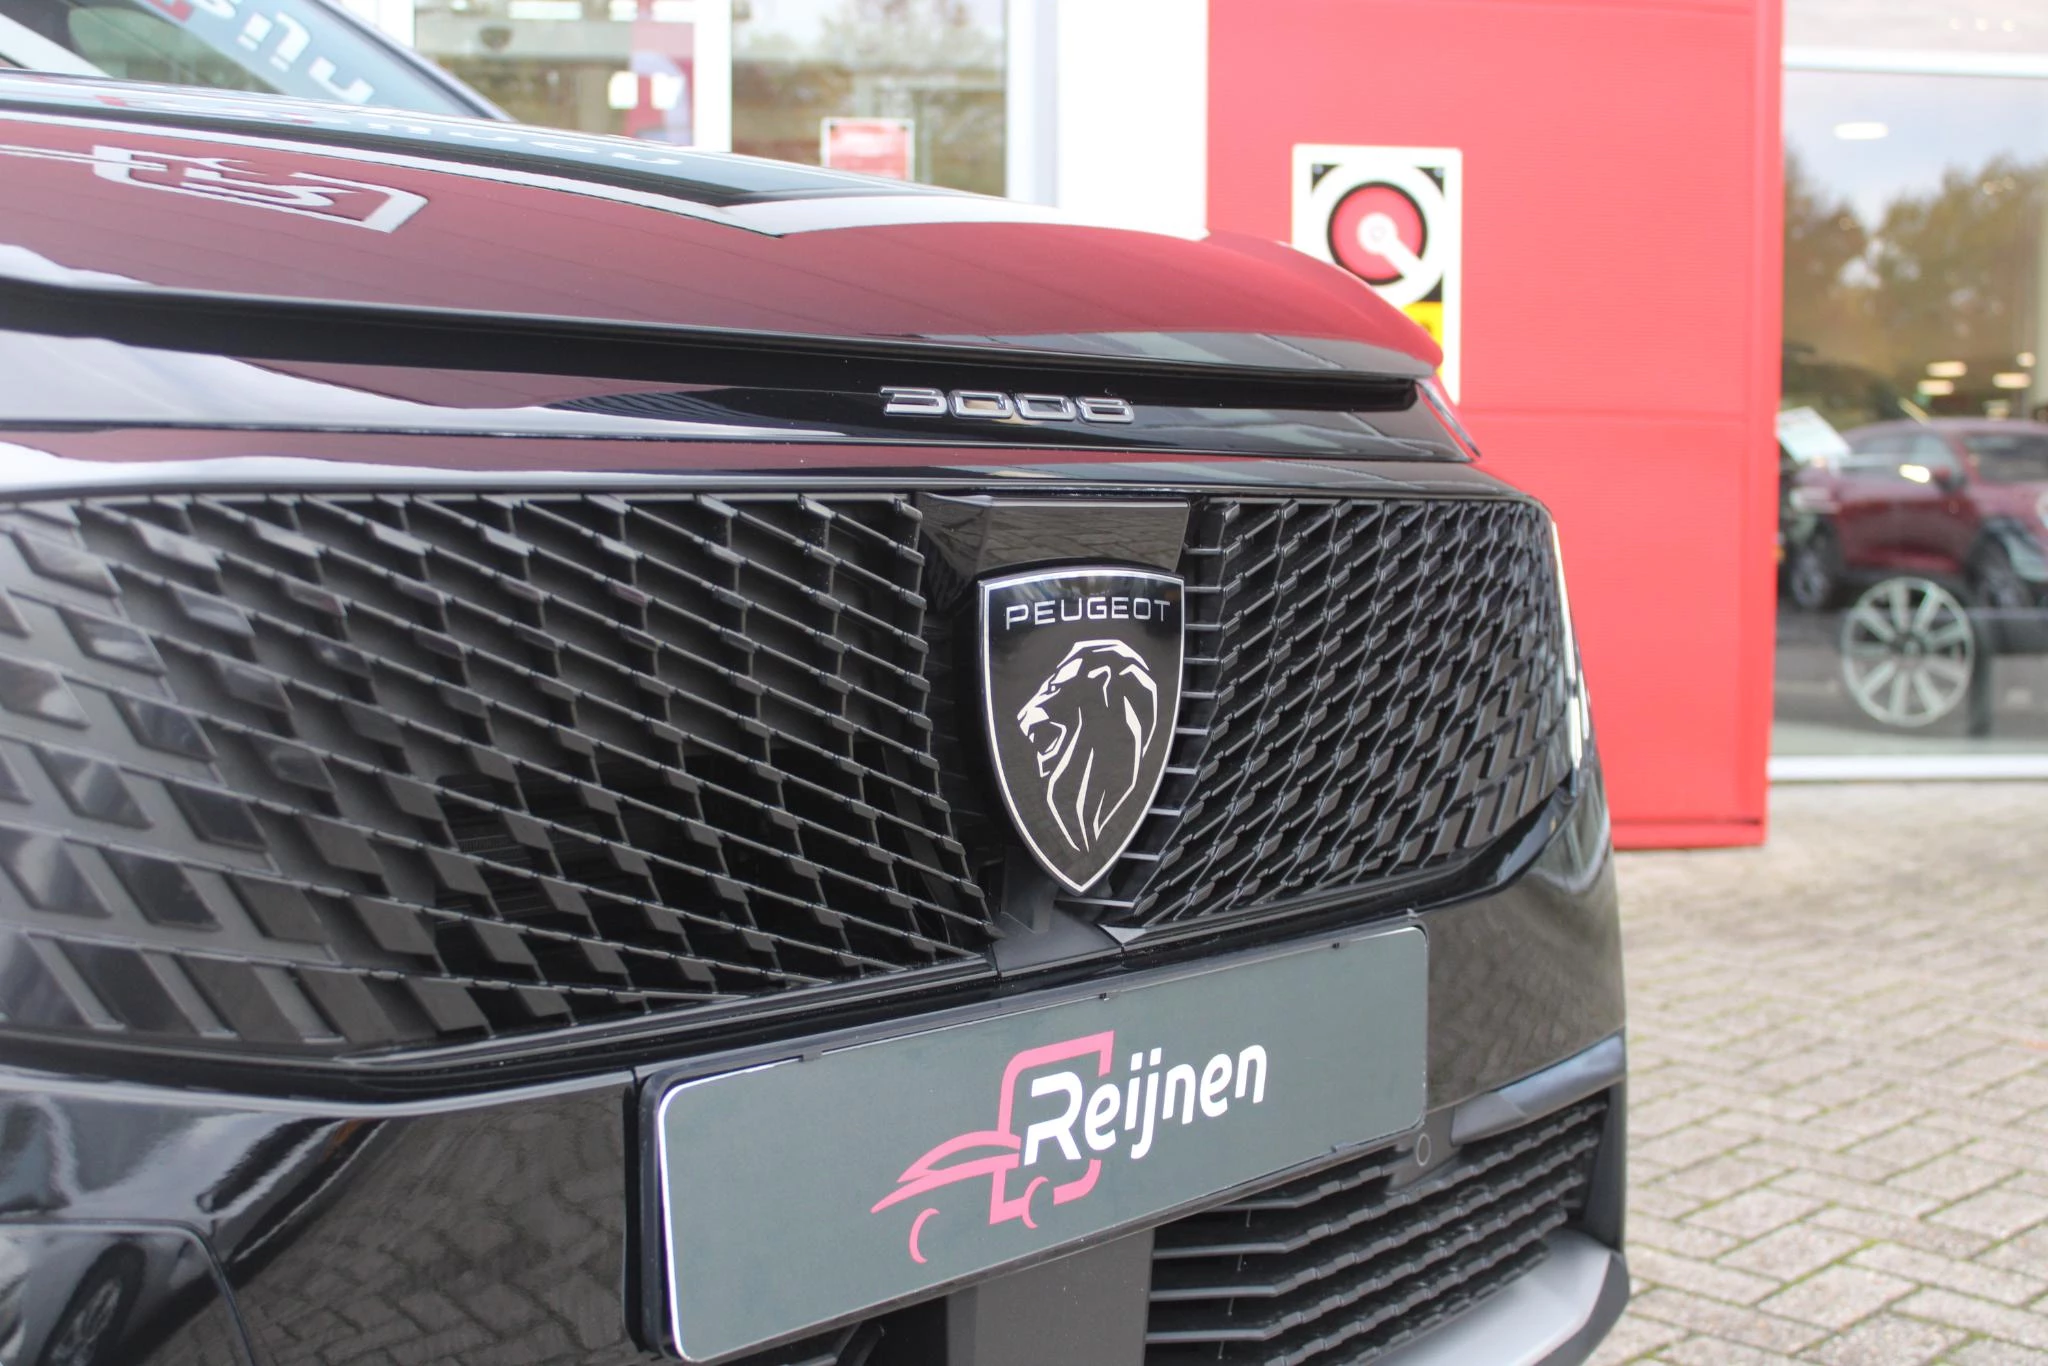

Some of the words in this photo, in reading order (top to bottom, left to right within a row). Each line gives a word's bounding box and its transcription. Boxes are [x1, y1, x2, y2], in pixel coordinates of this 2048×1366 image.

[879, 386, 1135, 424] 3008
[1005, 596, 1171, 631] PEUGEOT
[1023, 1044, 1268, 1167] Reijnen
